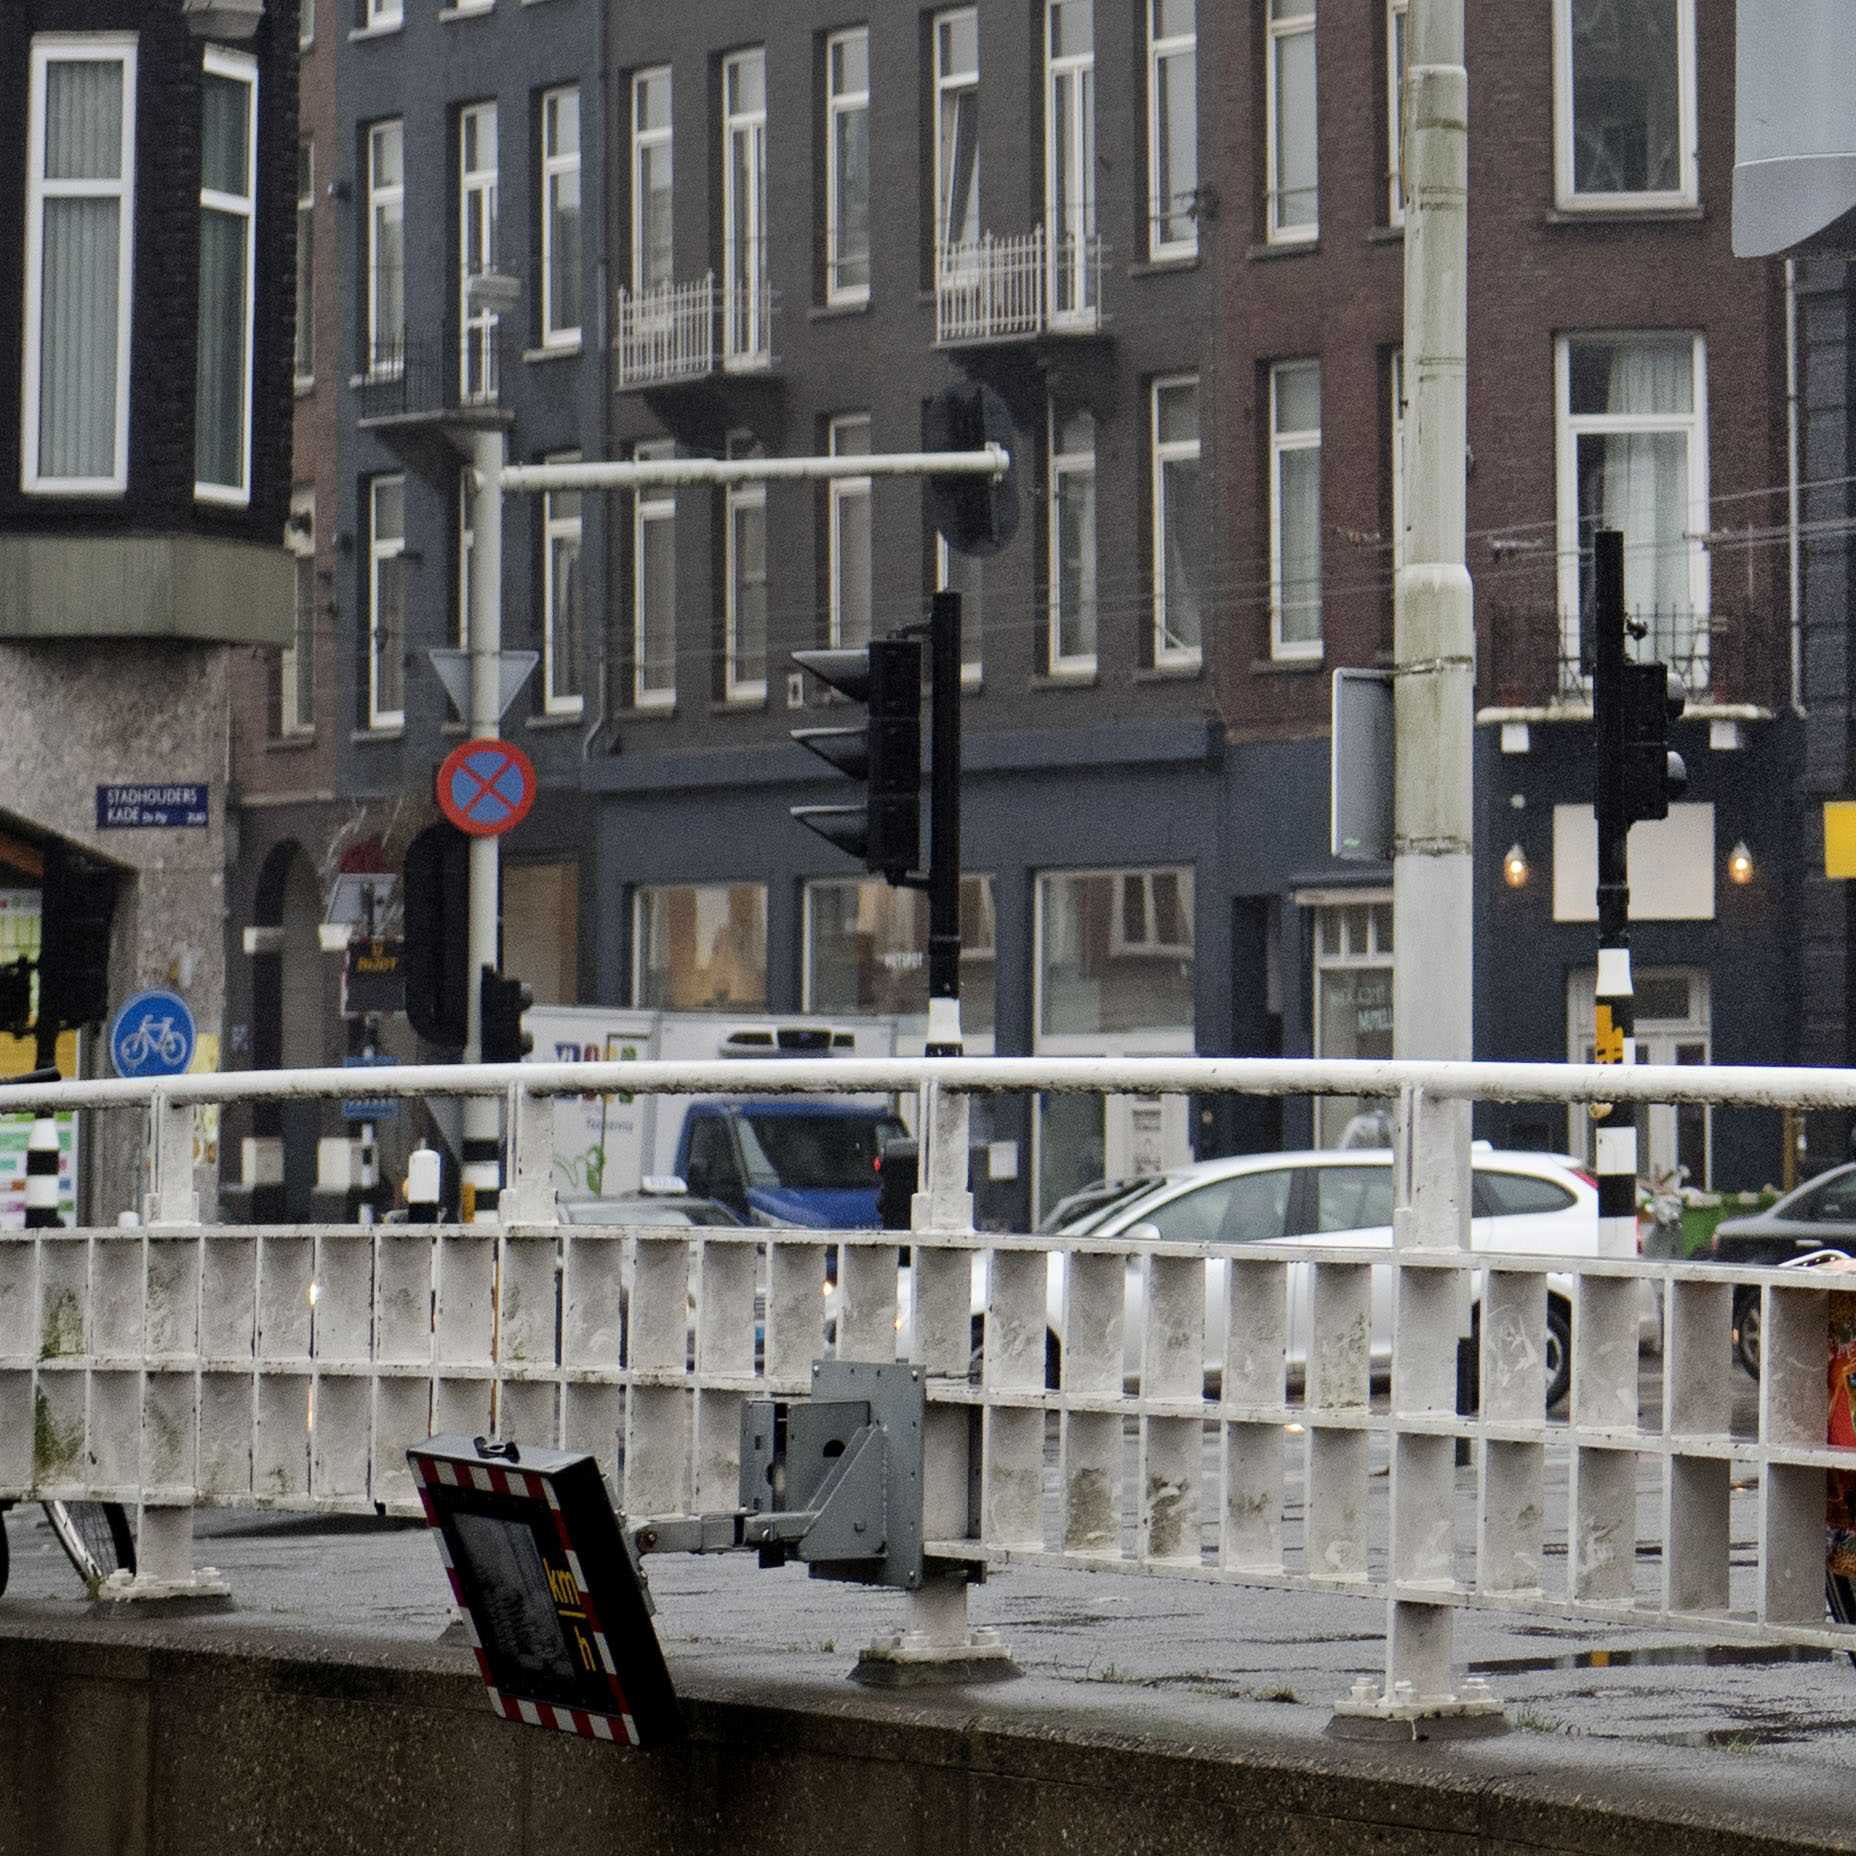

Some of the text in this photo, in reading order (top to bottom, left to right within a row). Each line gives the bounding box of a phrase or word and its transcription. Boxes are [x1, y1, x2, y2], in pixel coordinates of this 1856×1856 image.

[107, 788, 197, 805] STADHOUDERS
[108, 807, 139, 823] KADE
[543, 1557, 580, 1604] km
[574, 1625, 596, 1672] h
